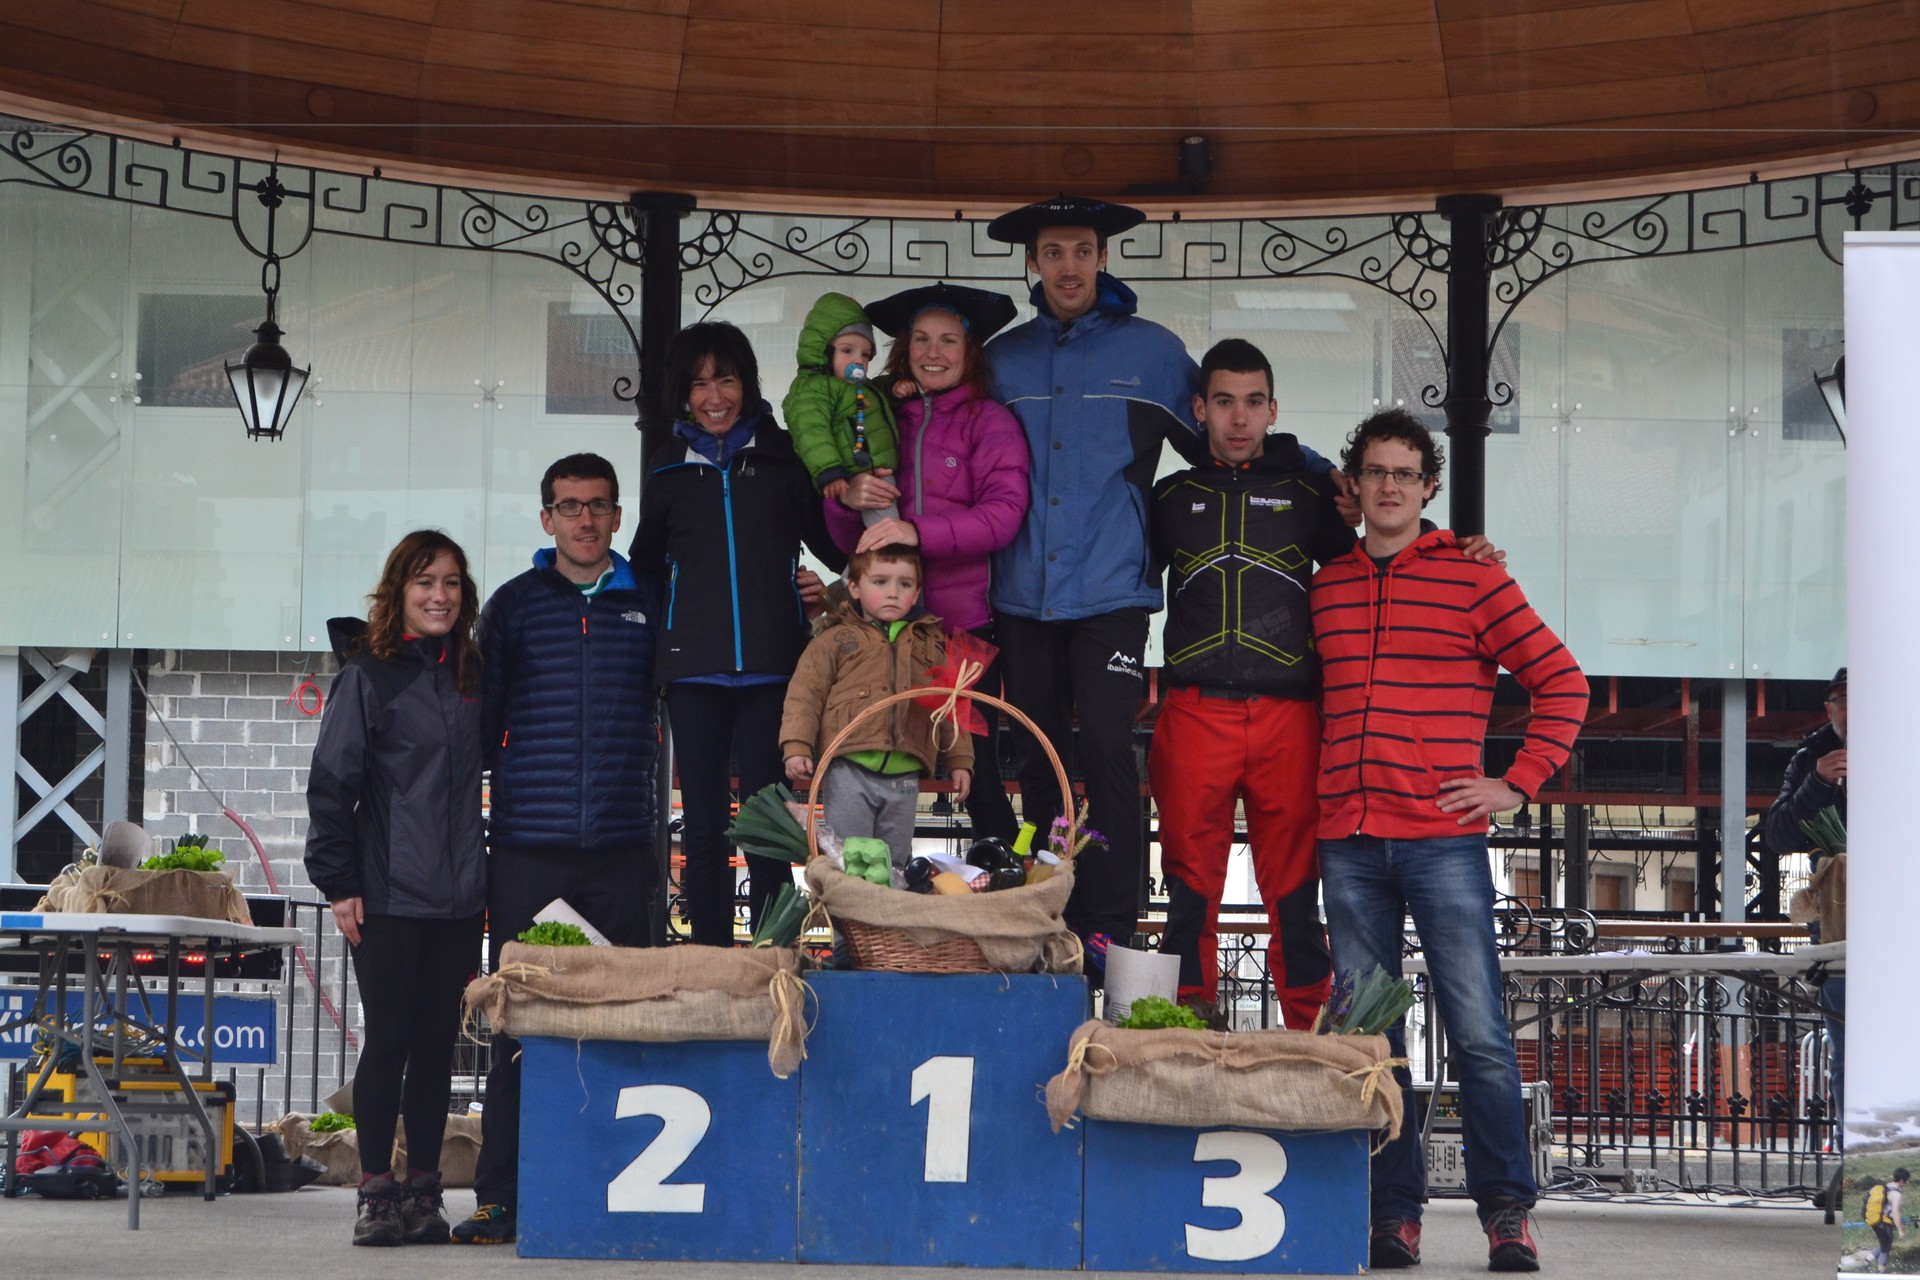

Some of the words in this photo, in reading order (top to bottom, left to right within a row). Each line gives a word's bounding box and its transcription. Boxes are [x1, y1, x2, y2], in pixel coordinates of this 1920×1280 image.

[605, 1084, 712, 1213] 2
[910, 1055, 975, 1184] 1
[1183, 1131, 1288, 1261] 3
